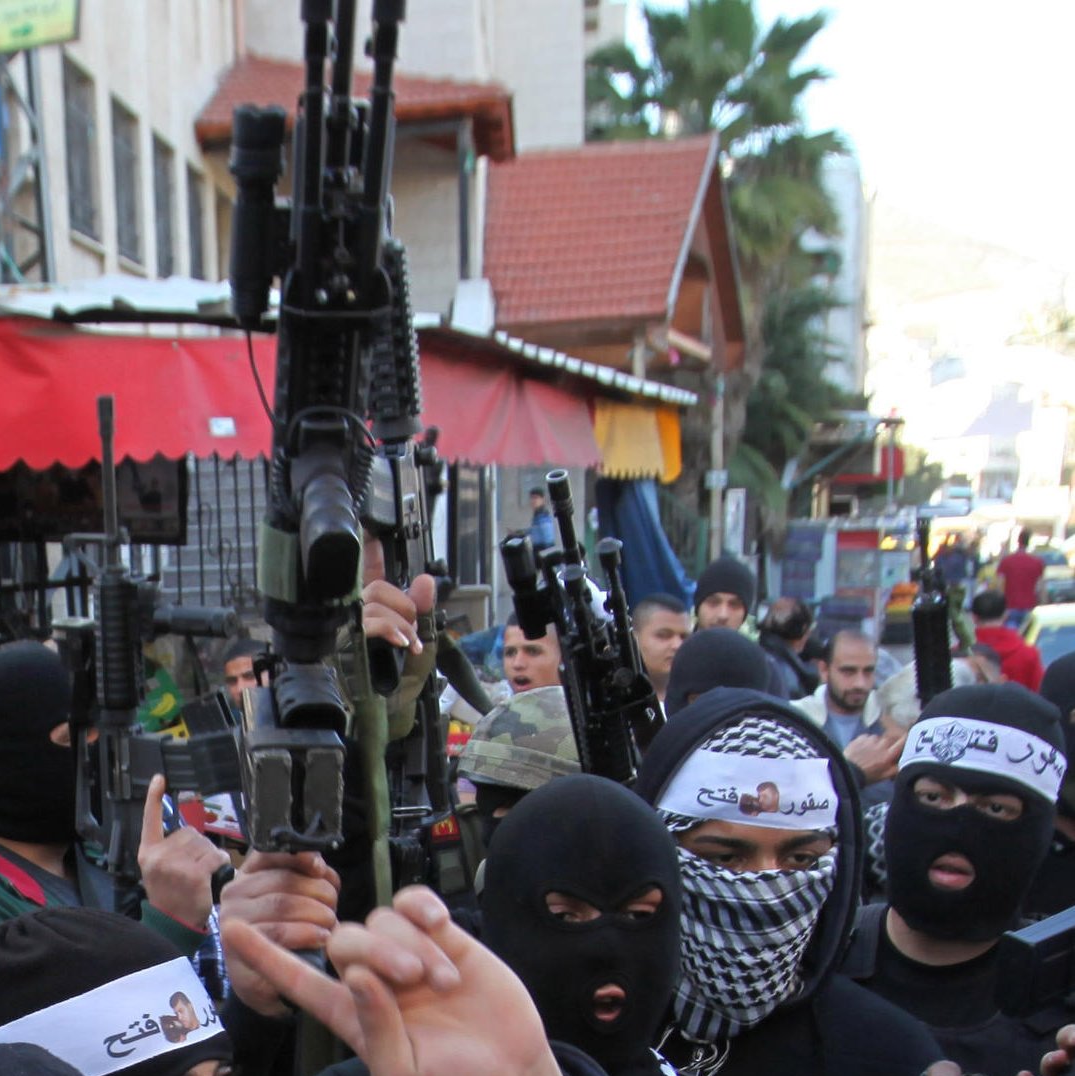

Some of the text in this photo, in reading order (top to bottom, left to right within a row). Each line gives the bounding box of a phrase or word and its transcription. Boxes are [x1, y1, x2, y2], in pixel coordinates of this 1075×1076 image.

[696, 786, 830, 817] صقور فتح
[102, 1013, 161, 1059] فتح
